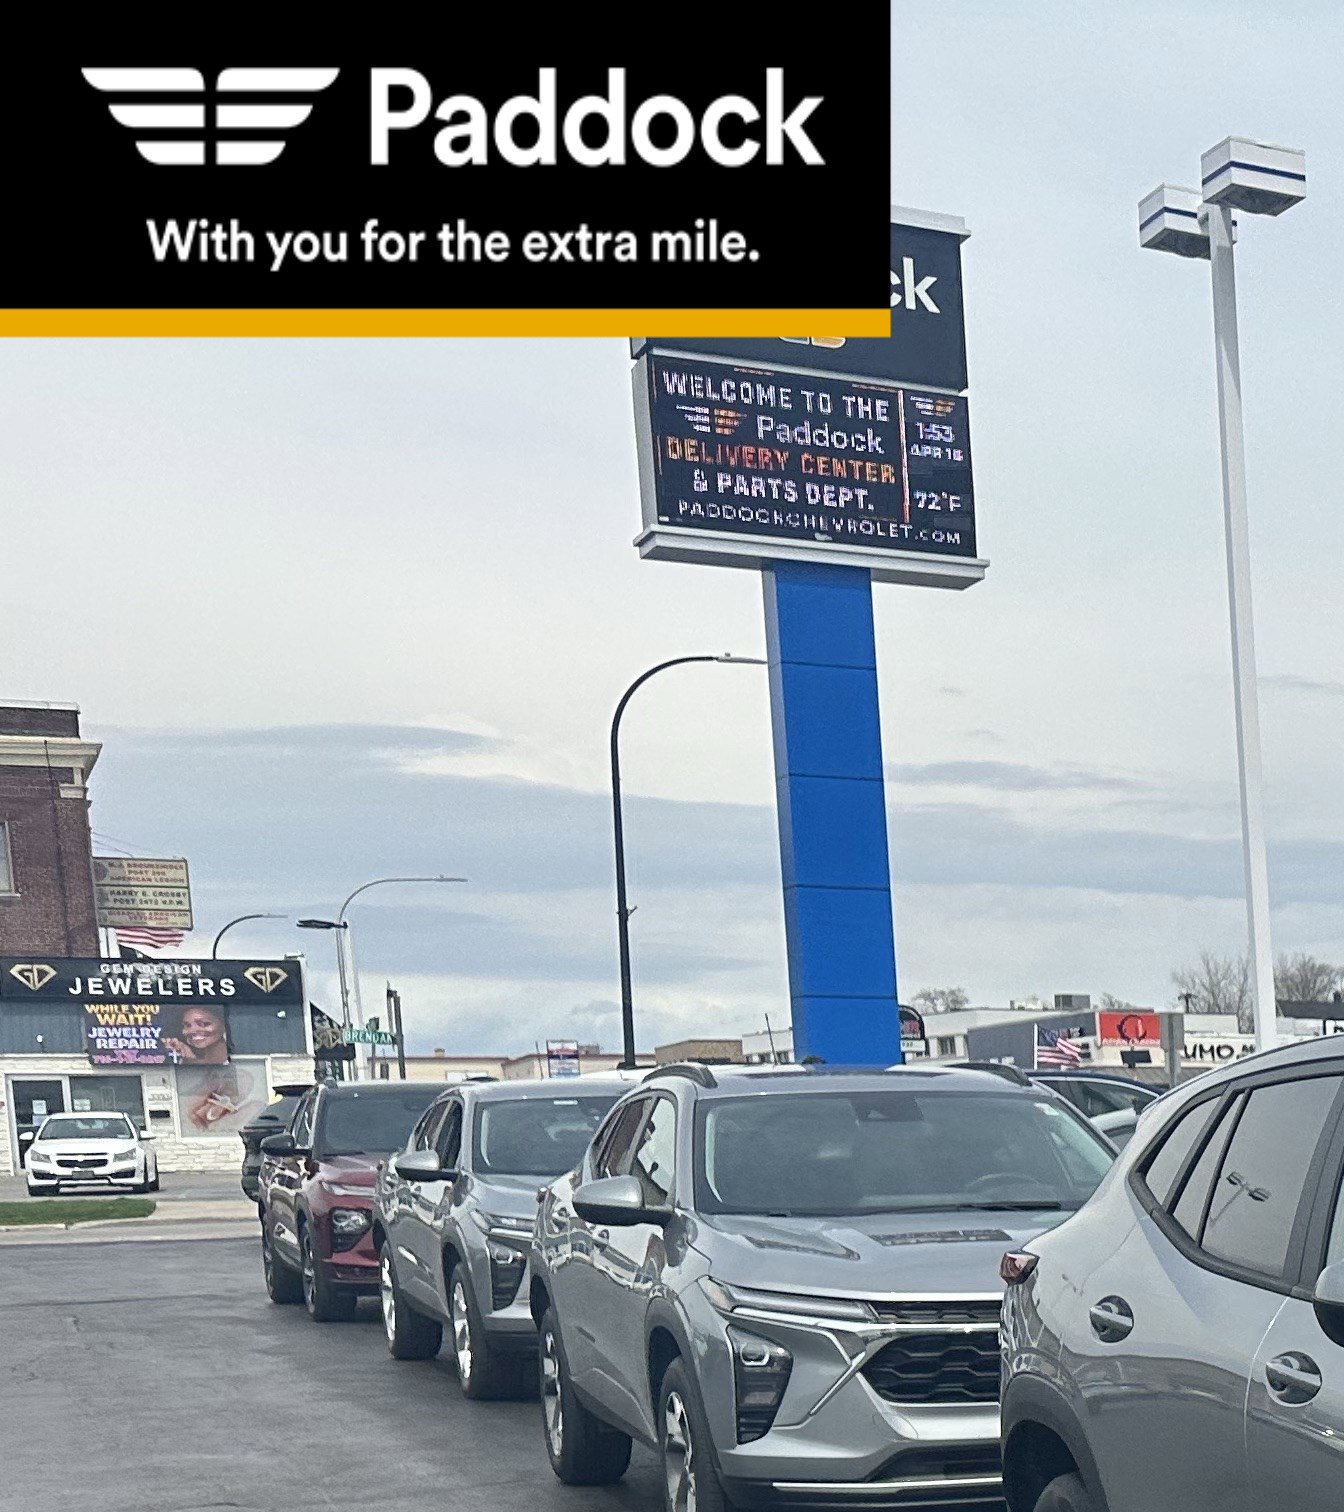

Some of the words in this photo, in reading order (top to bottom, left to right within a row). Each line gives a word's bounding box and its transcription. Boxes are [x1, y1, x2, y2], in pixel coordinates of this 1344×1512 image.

[663, 371, 792, 410] WELCOME
[801, 390, 831, 415] TO
[842, 394, 890, 422] THE
[757, 415, 885, 454] Paddock
[667, 436, 789, 471] DELIVERY
[801, 452, 896, 484] CENTER
[717, 472, 799, 503] PARTS
[806, 482, 875, 511] DEPT.
[100, 963, 134, 974] GEM
[139, 963, 202, 975] DESIGN
[68, 977, 237, 996] JEWELERS
[84, 1004, 129, 1014] WHILE
[132, 1004, 160, 1015] YOU
[96, 1014, 152, 1026] WAIT!
[88, 1027, 161, 1038] JEWELRY
[96, 1038, 157, 1049] REPAIR
